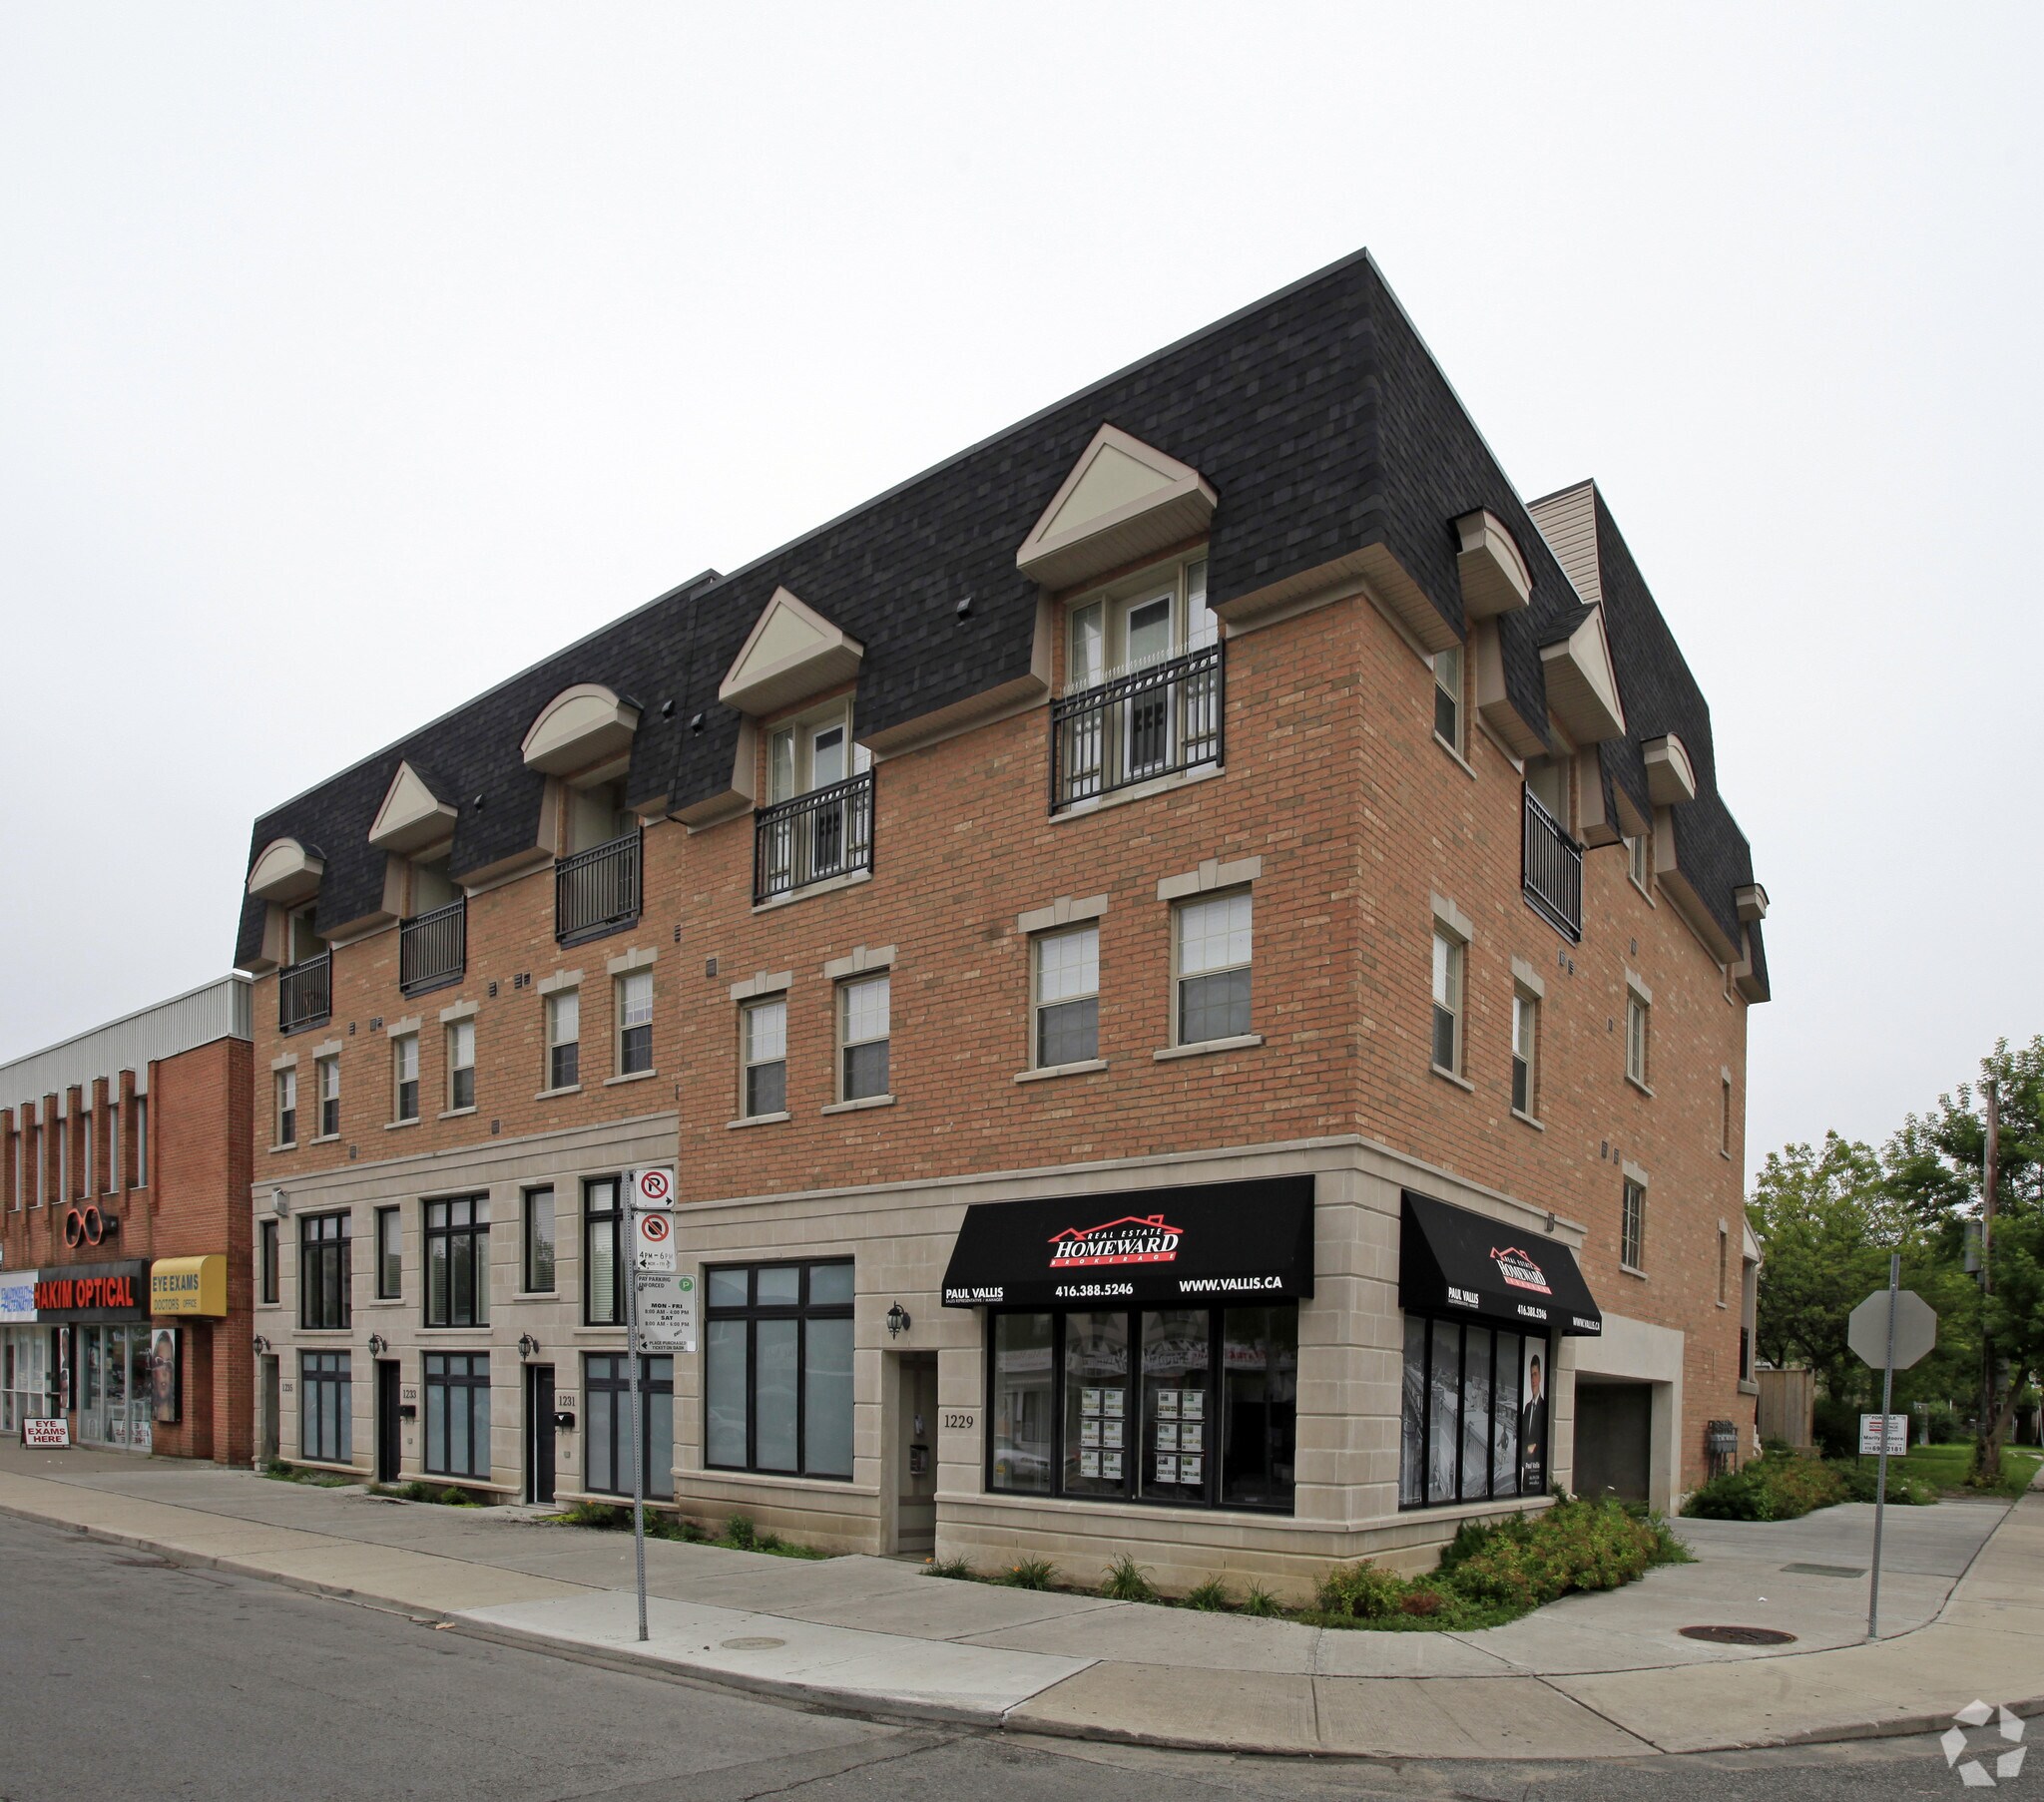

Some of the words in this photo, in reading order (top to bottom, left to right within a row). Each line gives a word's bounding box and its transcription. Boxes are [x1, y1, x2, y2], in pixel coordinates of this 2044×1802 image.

[1121, 1228, 1162, 1237] ESTATE
[1054, 1233, 1179, 1258] HOMEWARD
[1051, 1253, 1175, 1266] BROKERAGE
[1496, 1259, 1546, 1286] HOMEWARD
[152, 1275, 168, 1292] EYE
[169, 1273, 199, 1291] EXAMS
[1179, 1276, 1282, 1292] WWW.VALLIS.CA
[34, 1280, 73, 1309] HAKIM
[76, 1276, 134, 1308] OPTICAL
[945, 1288, 970, 1299] PAUL
[972, 1287, 1004, 1298] VALLIS
[1055, 1283, 1134, 1297] 416.388.5246
[1448, 1286, 1462, 1300] PAUL
[1462, 1290, 1479, 1304] VALLIS
[183, 1299, 197, 1308] OFFICE
[281, 1383, 293, 1392] 1235
[402, 1389, 417, 1399] 1233
[558, 1395, 576, 1407] 1231
[944, 1414, 974, 1429] 1229
